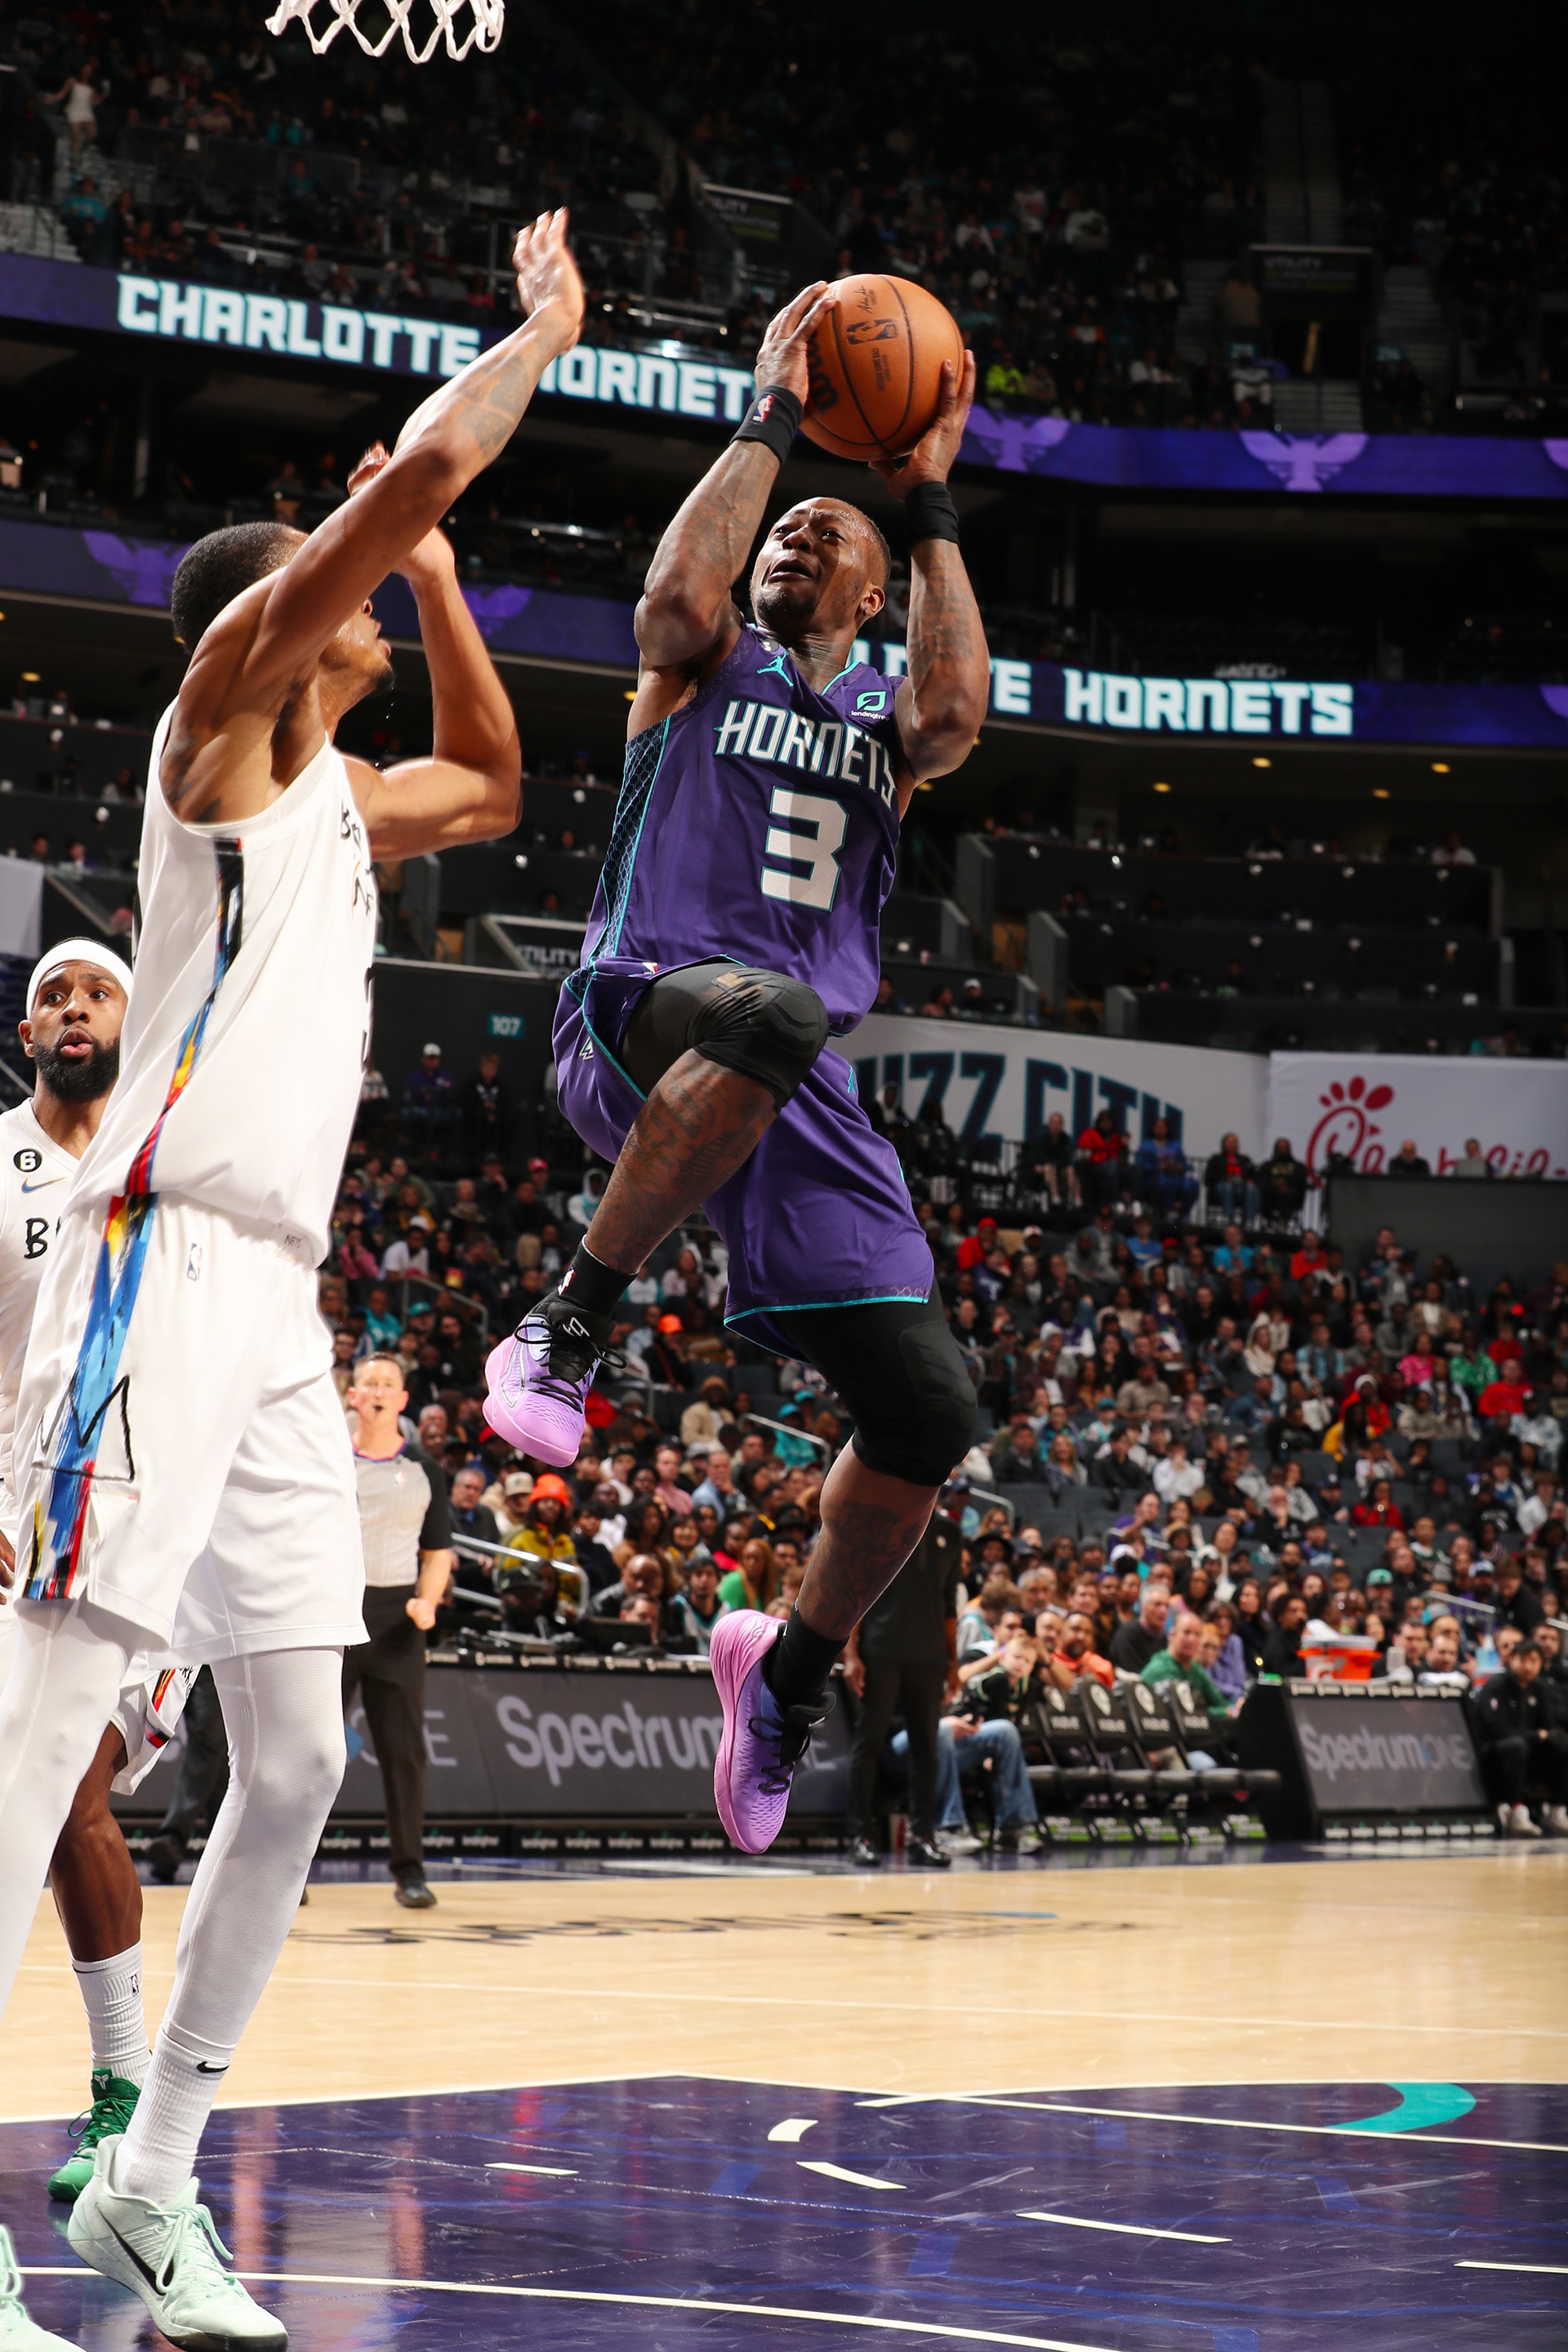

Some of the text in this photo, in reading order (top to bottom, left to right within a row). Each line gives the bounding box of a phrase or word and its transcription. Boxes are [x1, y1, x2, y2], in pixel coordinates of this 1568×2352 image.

[116, 274, 481, 379] CHARLOTTE
[538, 344, 756, 423] ORNET
[1063, 667, 1353, 735] HORNETS
[713, 700, 898, 811] HORNETS
[760, 785, 849, 912] 3
[491, 1014, 522, 1036] 107
[20, 1152, 36, 1170] 6
[1299, 1722, 1429, 1783] Spectrum
